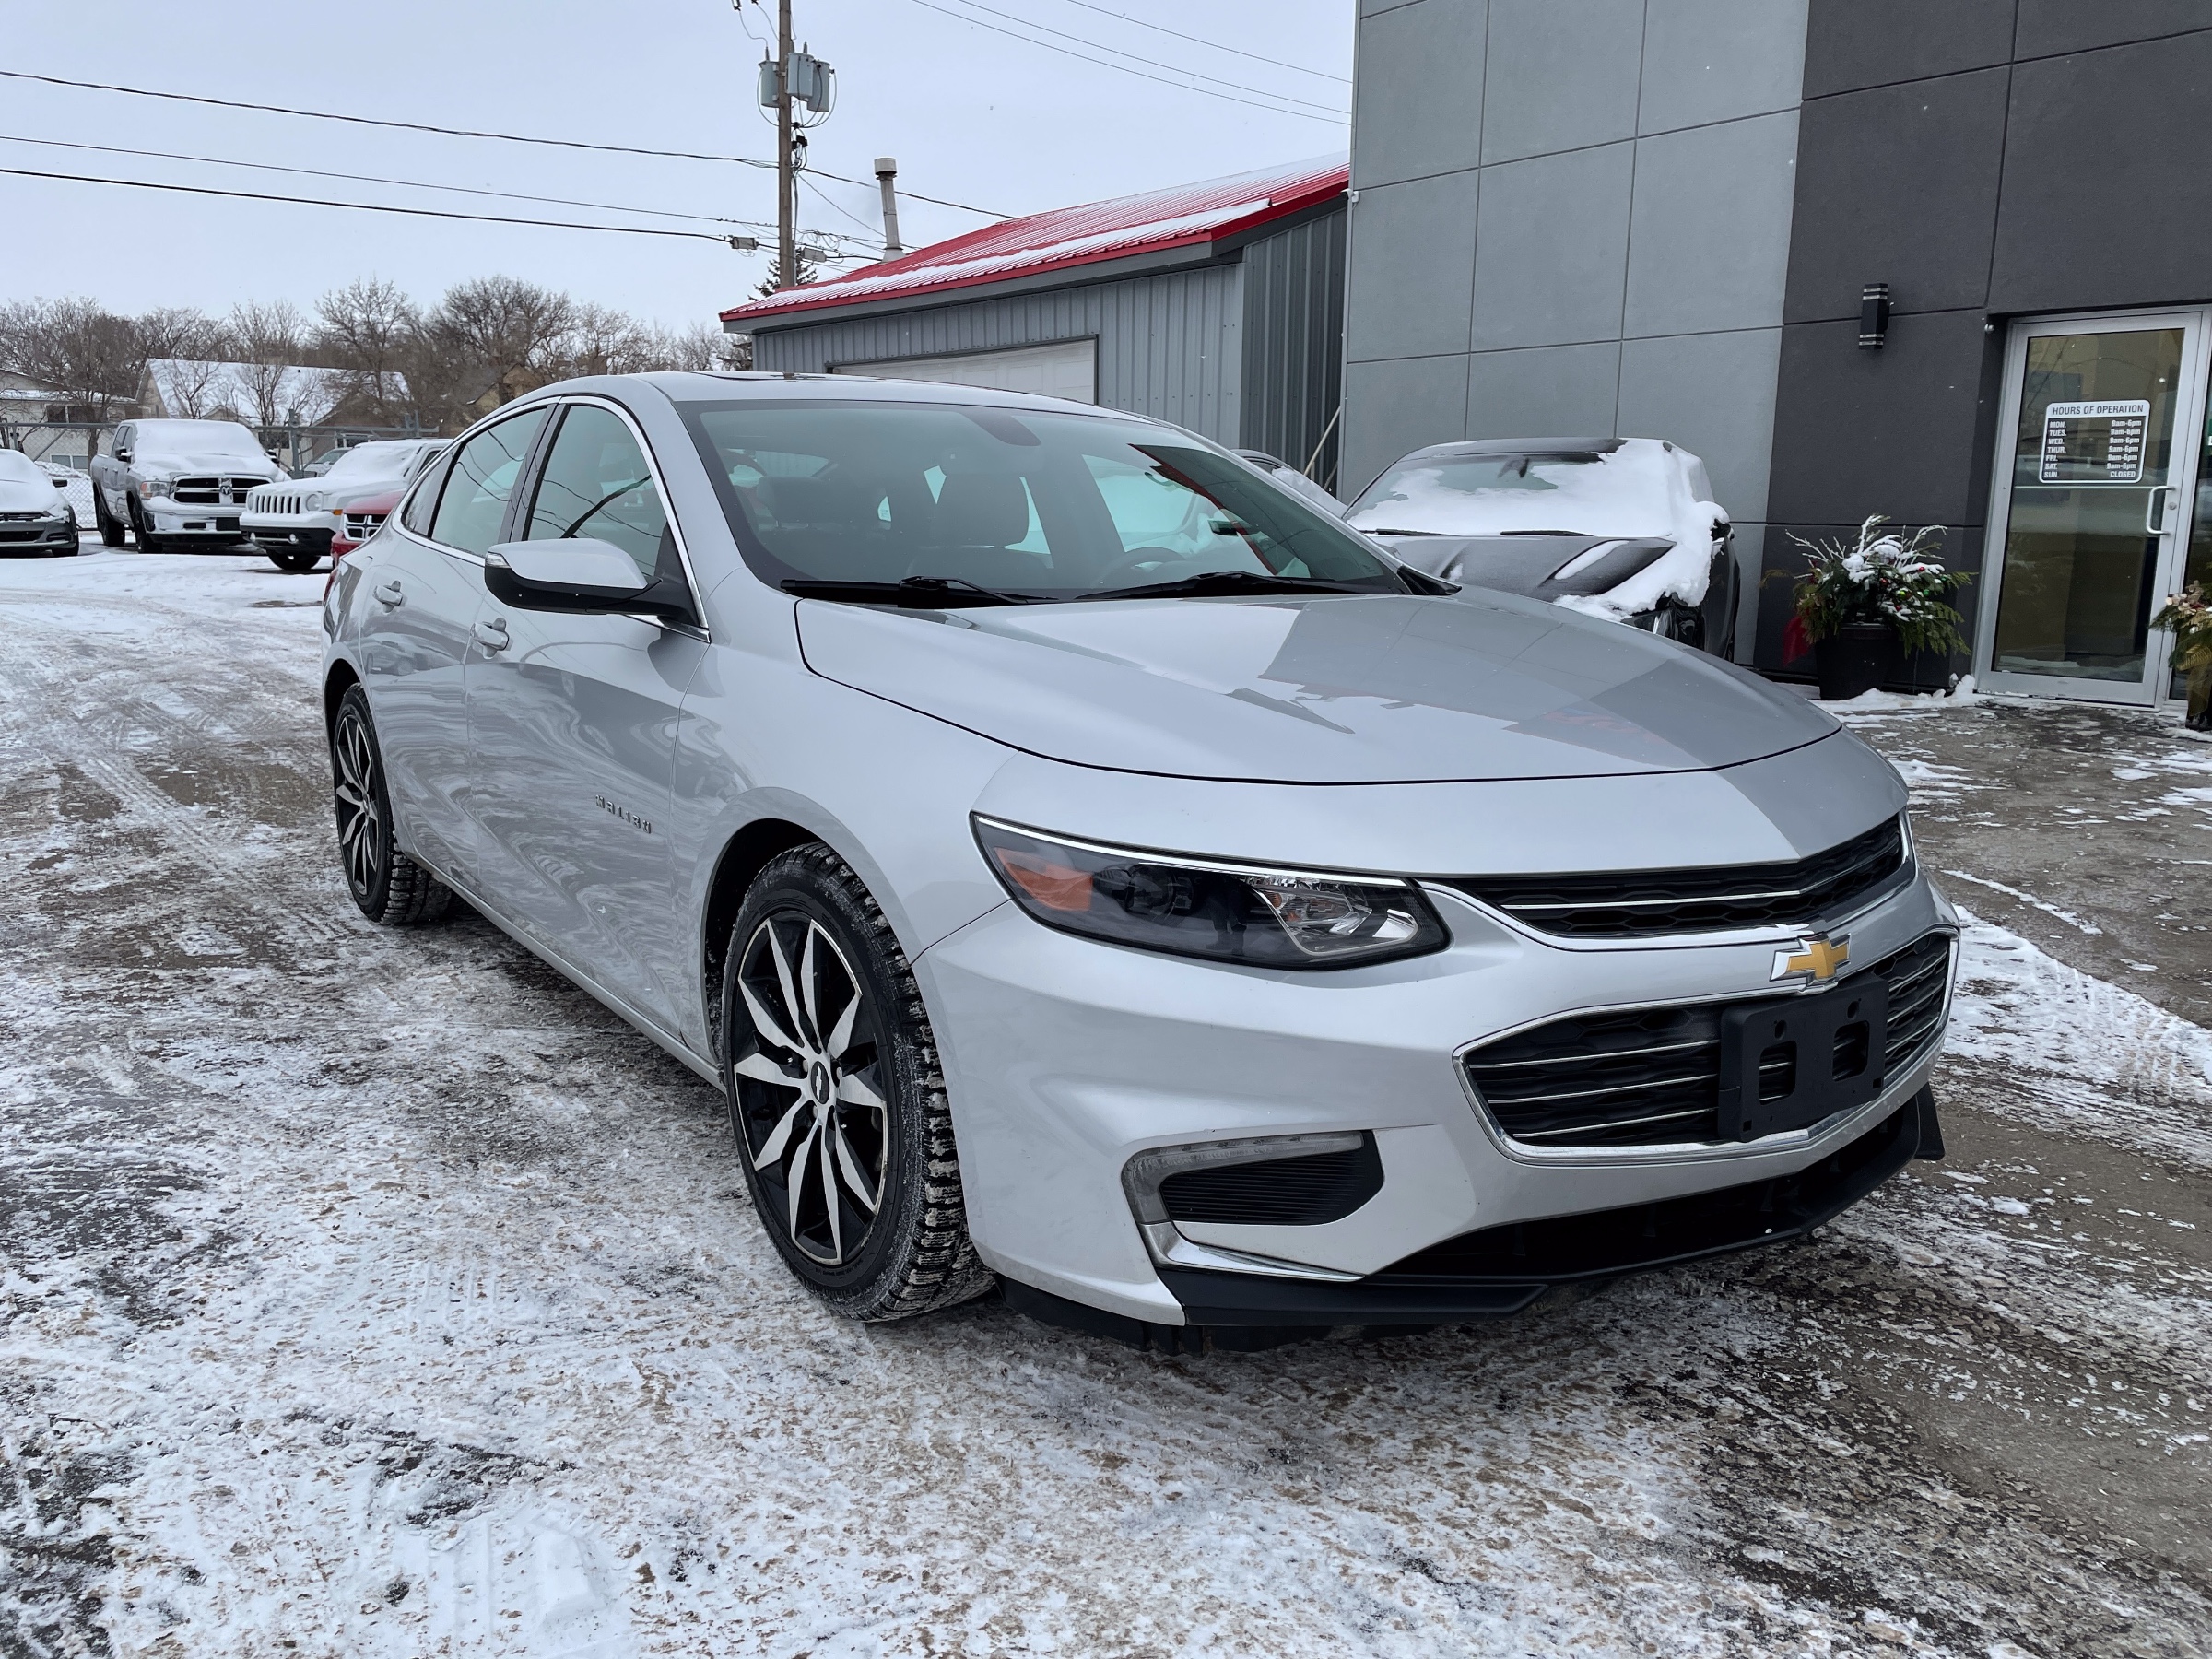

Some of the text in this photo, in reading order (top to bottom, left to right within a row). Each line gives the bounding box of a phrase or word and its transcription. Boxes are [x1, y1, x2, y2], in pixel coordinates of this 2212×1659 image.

[2053, 405, 2144, 415] HOURS OF OPERATION
[595, 794, 652, 834] MALIBU
